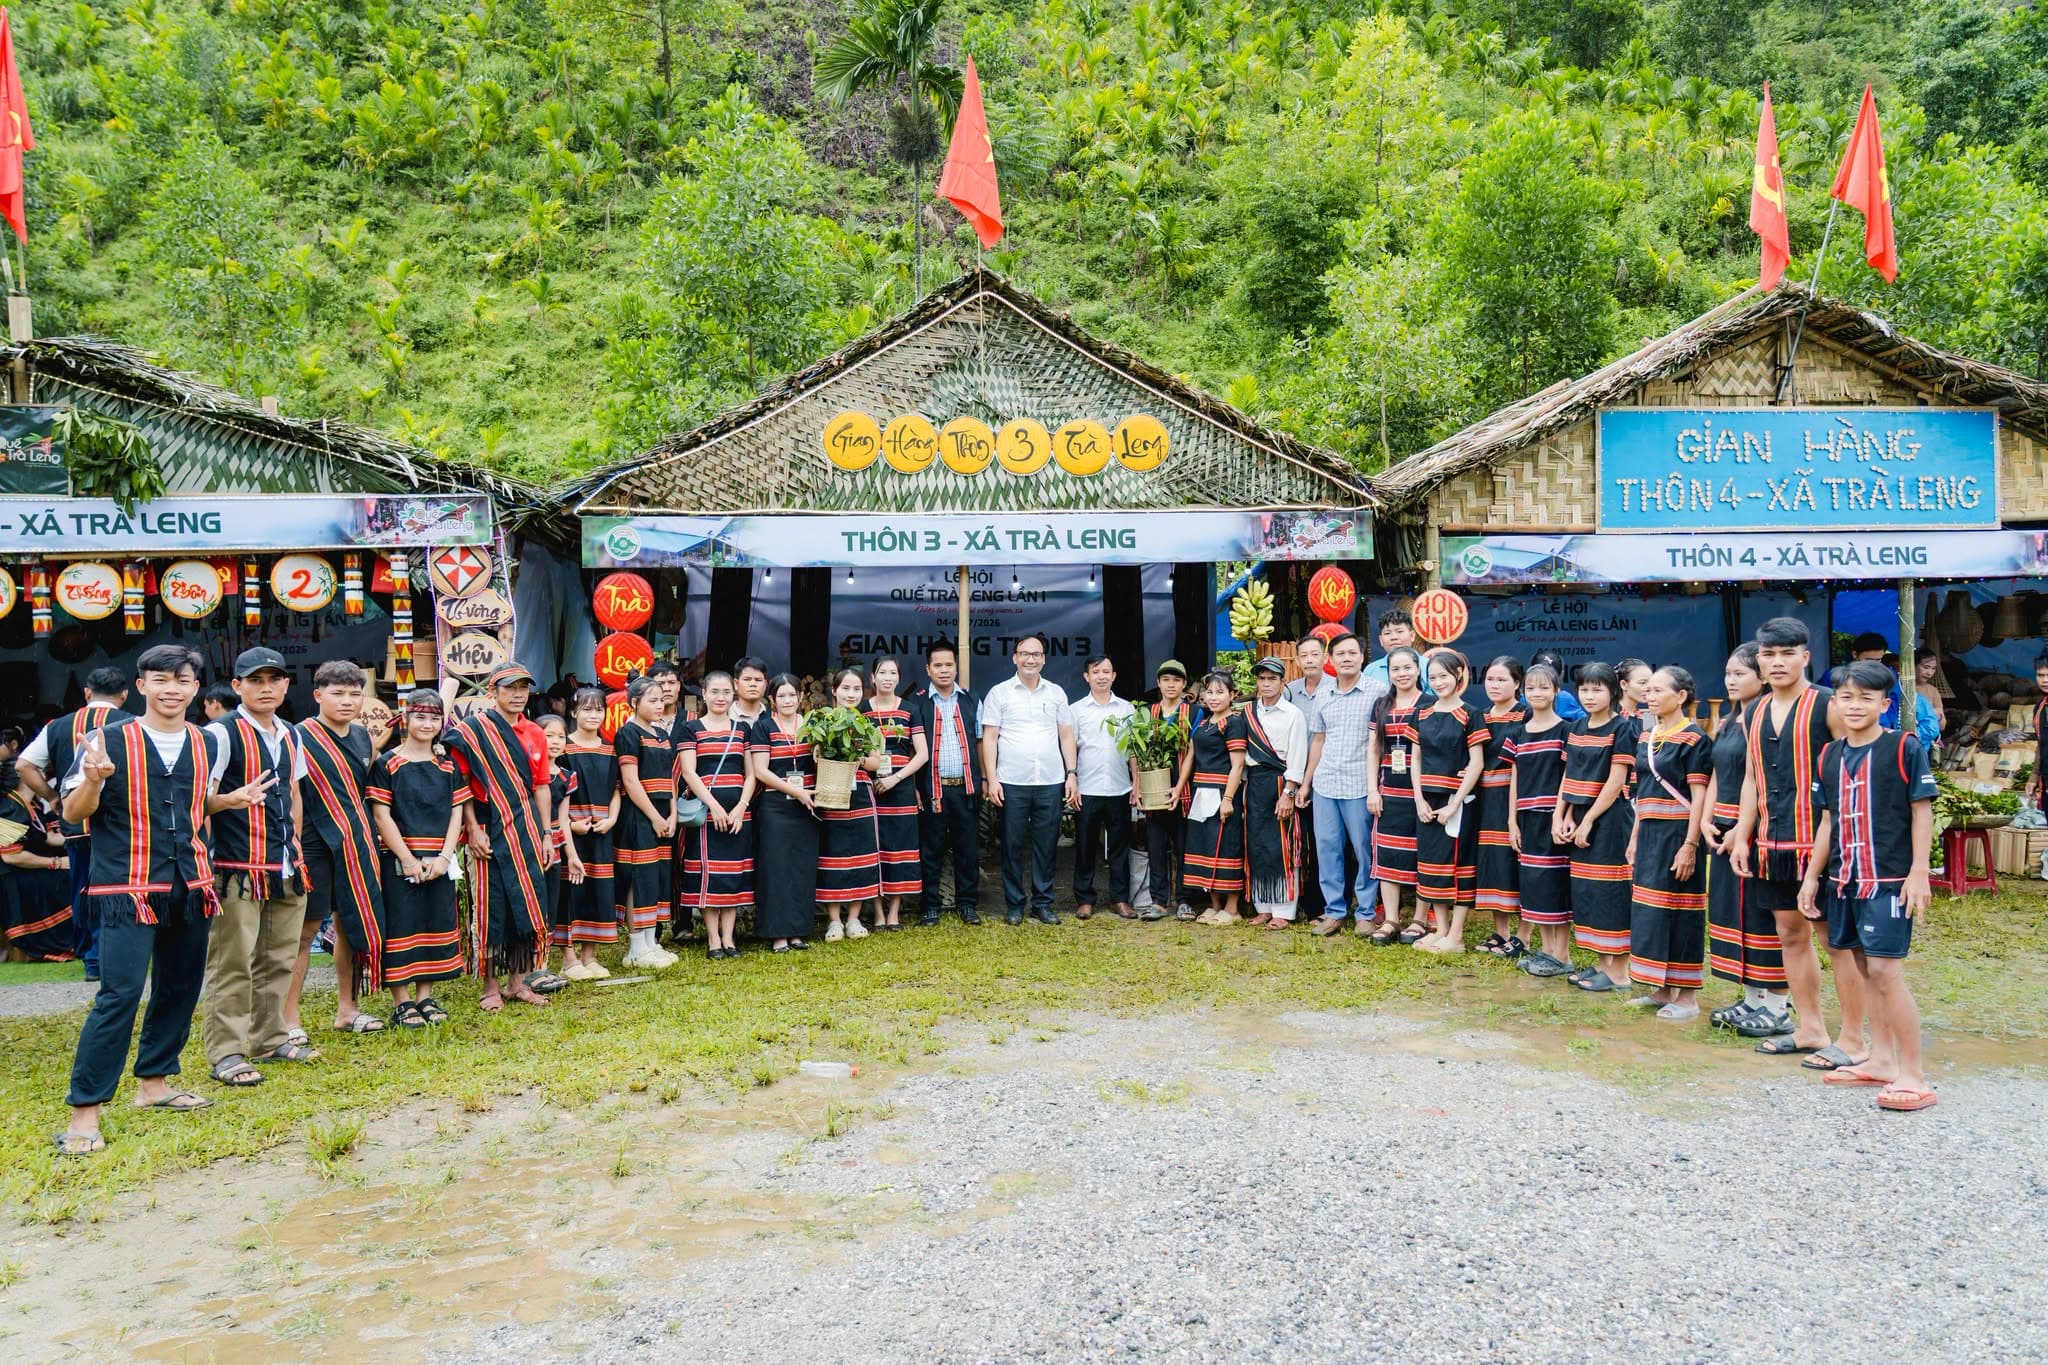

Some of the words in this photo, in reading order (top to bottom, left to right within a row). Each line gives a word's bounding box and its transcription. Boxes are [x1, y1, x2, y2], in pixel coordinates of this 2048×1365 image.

[832, 422, 874, 456] Gian
[886, 424, 934, 461] Hàng
[948, 430, 989, 461] Thôn
[1008, 428, 1034, 461] 3
[1065, 425, 1101, 460] Trà
[1121, 428, 1164, 460] Leng
[1804, 415, 1922, 463] HÀNG
[30, 450, 61, 464] Leng
[1615, 472, 1712, 512] THÔN
[1719, 476, 1742, 509] 4
[1767, 467, 1816, 512] XÃ
[1822, 465, 1893, 510] TRÀ
[1898, 475, 1982, 510] LENG
[20, 509, 63, 535] XÃ
[69, 508, 136, 535] TRÀ
[141, 512, 221, 535] LENG
[841, 526, 917, 552] THÔN
[924, 531, 941, 551] 3
[963, 525, 1000, 551] XÃ
[1006, 525, 1061, 550] TRÀ
[1067, 528, 1136, 549] LENG
[1666, 544, 1732, 567] THÔN
[1740, 549, 1756, 566] 4
[1777, 543, 1809, 566] XÃ
[1814, 543, 1861, 566] TRÀ
[1870, 547, 1927, 565] LENG
[288, 569, 321, 599] 2
[968, 570, 993, 585] HỘI
[604, 585, 650, 617] Trà
[891, 584, 924, 601] QUẾ
[928, 586, 960, 601] TRÀ
[969, 589, 1004, 602] ENG
[1007, 585, 1039, 603] LẦN
[1564, 600, 1588, 616] HỘI
[1495, 616, 1526, 632] QUẾ
[1530, 618, 1558, 631] TRÀ
[1561, 620, 1598, 631] LENG
[1602, 618, 1630, 631] LẦN
[447, 641, 494, 669] Hiệu
[848, 634, 908, 656] GIAN
[1075, 637, 1091, 656] 3
[602, 645, 647, 676] Leng
